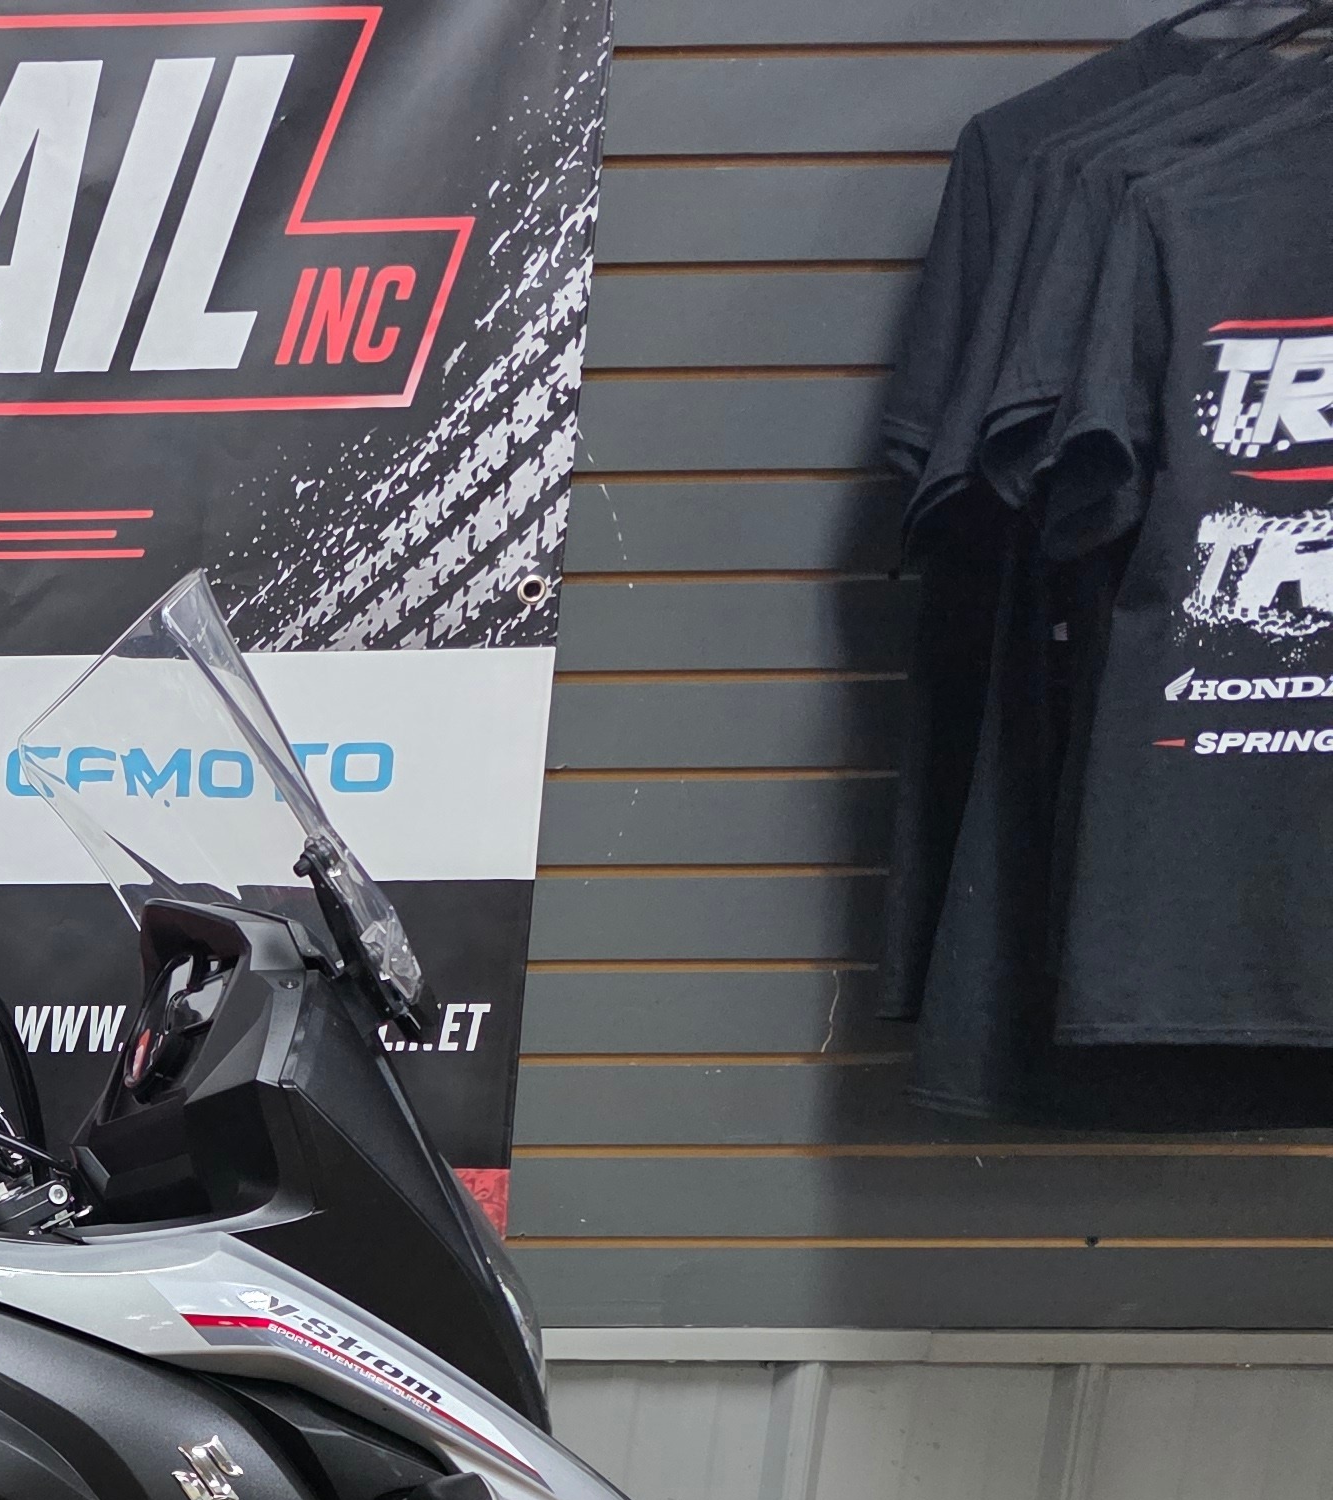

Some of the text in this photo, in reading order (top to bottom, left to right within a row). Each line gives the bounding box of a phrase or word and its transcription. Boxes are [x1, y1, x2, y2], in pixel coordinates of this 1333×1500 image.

[275, 264, 416, 366] INC
[1189, 676, 1333, 700] HOND
[267, 1323, 433, 1413] SPORT ADVENTURE TOURER
[268, 1295, 443, 1404] V-Strom
